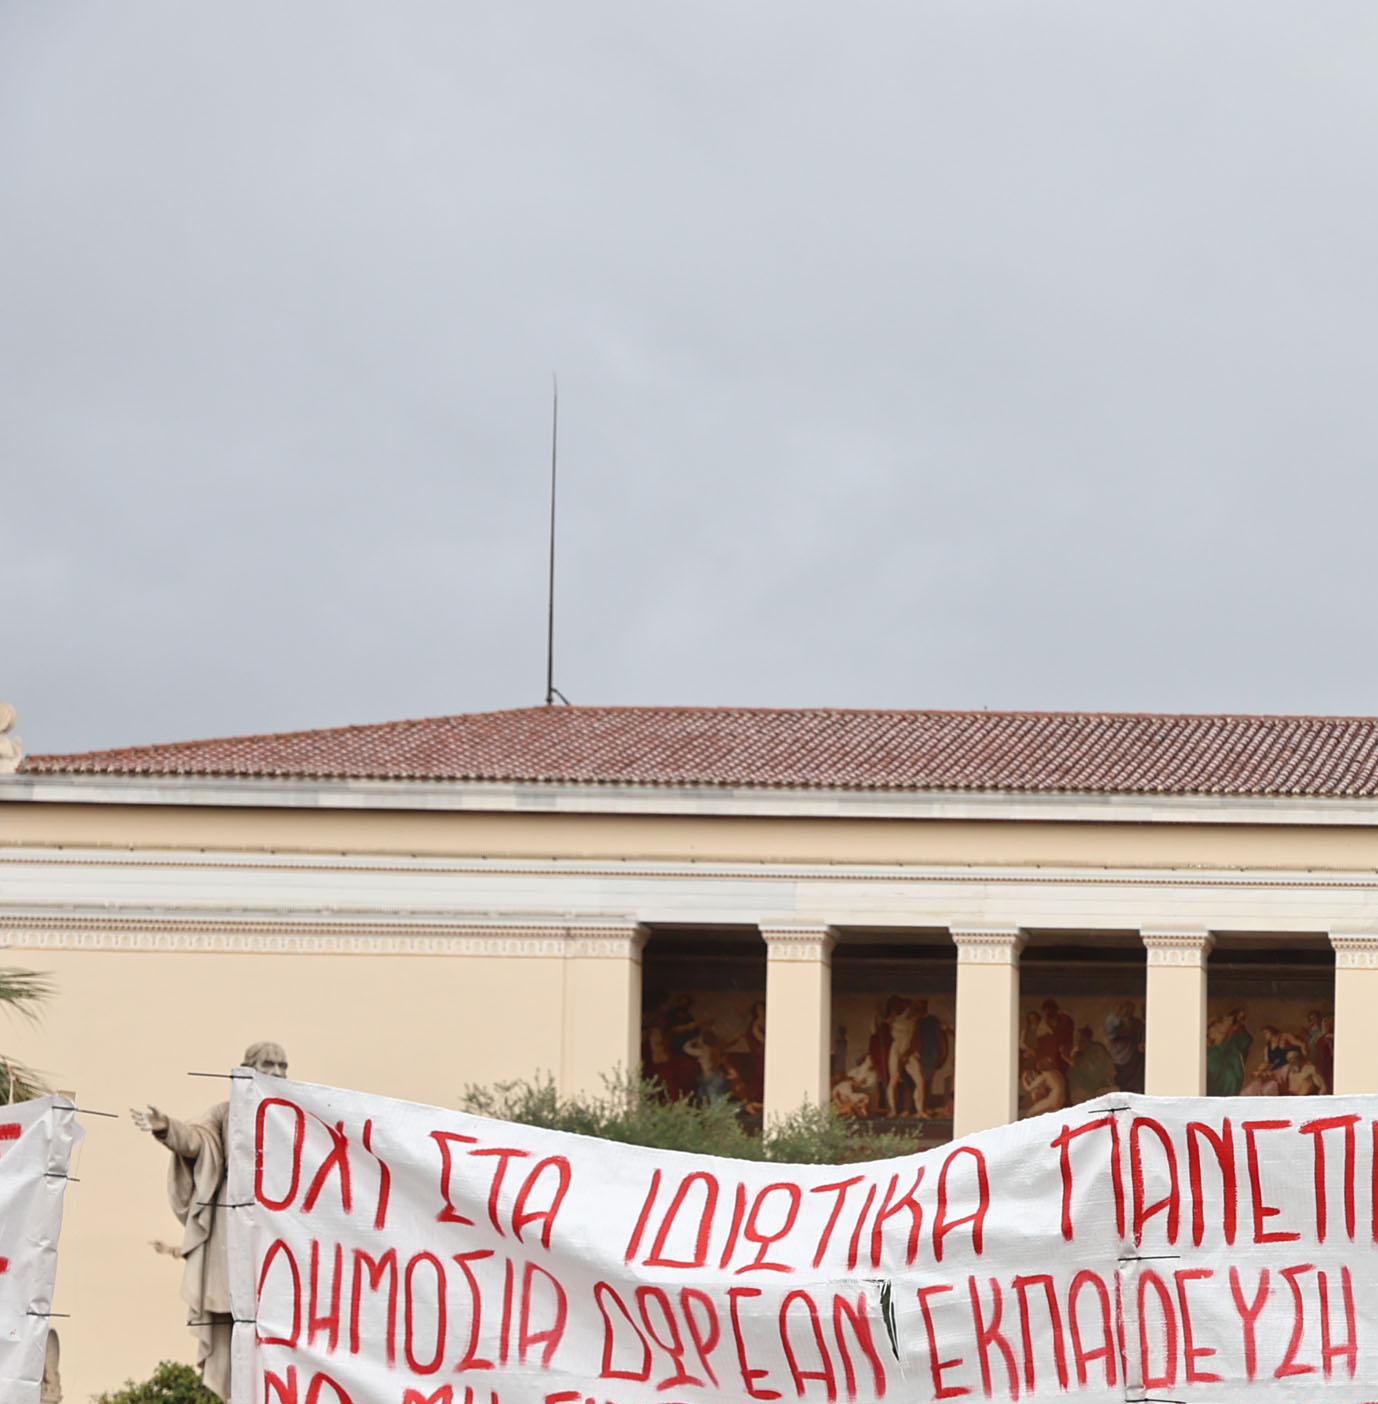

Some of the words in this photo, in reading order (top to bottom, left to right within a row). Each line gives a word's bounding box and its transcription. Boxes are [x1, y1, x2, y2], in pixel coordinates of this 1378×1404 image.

[255, 1099, 392, 1231] ΟΧΙ
[431, 1132, 572, 1251] ΣΤΑ
[626, 1147, 991, 1275] ΙΔΙΩΤΙΚΑ
[257, 1240, 569, 1376] ΔΗΜΟΣΙΑ
[595, 1282, 887, 1404] ΔΩΡΕΑΝ
[919, 1265, 1359, 1403] ΕΚΠΑΙΔΕΥΣΗ
